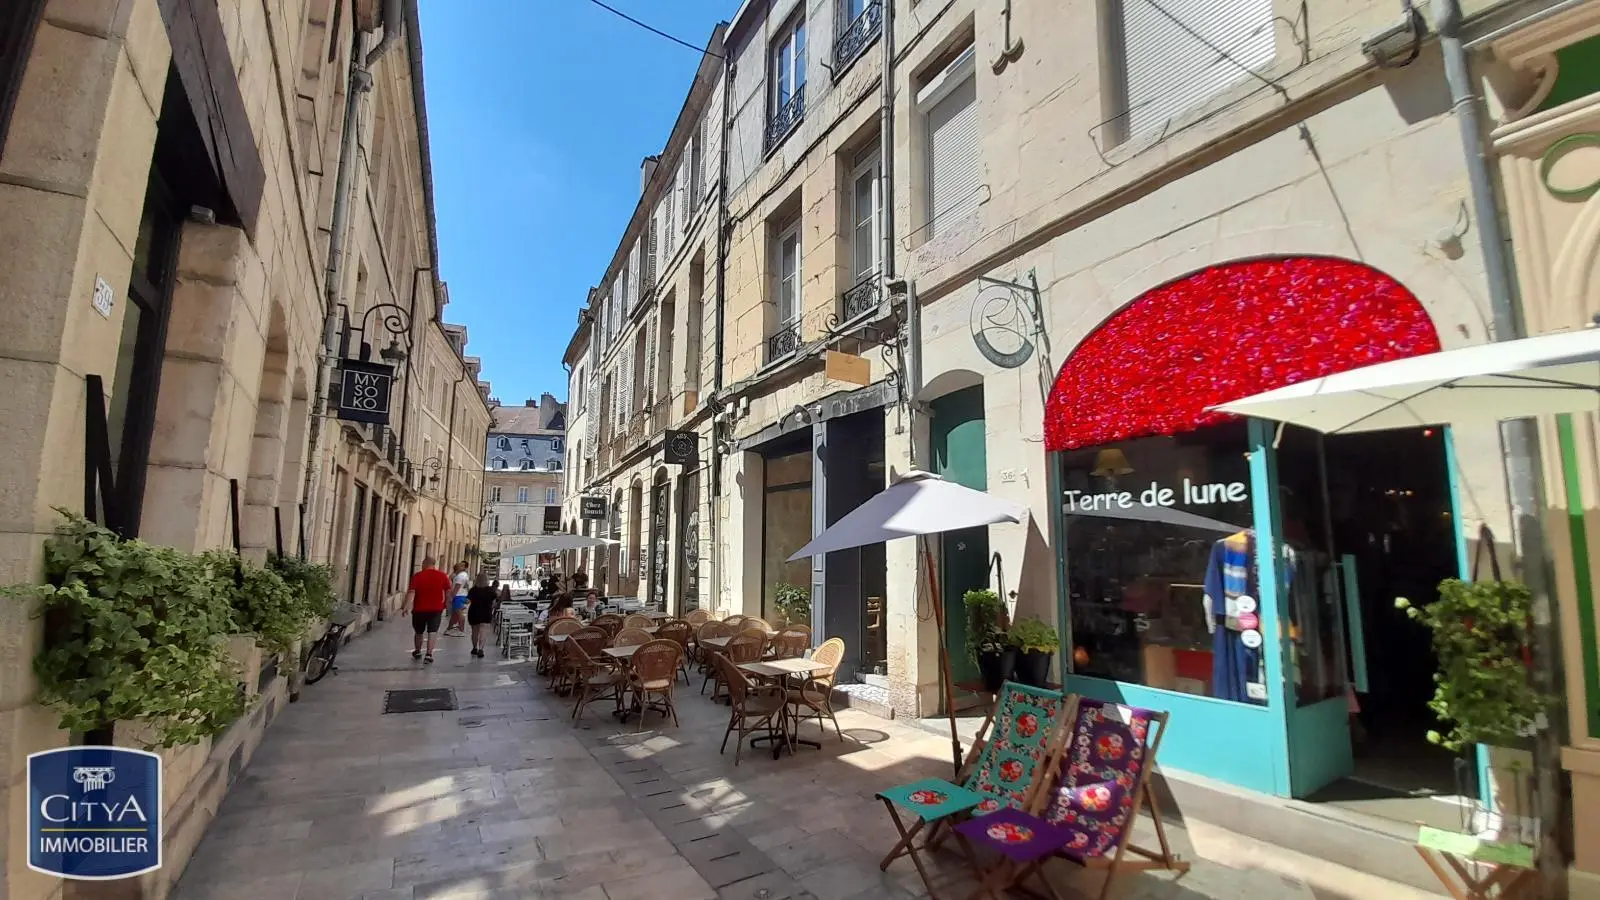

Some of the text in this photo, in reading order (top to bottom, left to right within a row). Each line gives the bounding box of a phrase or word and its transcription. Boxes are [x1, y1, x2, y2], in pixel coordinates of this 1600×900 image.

[97, 281, 111, 310] 39
[354, 373, 380, 386] MY
[354, 384, 378, 398] SO
[353, 396, 377, 409] KO
[1063, 478, 1248, 512] Terre de lune
